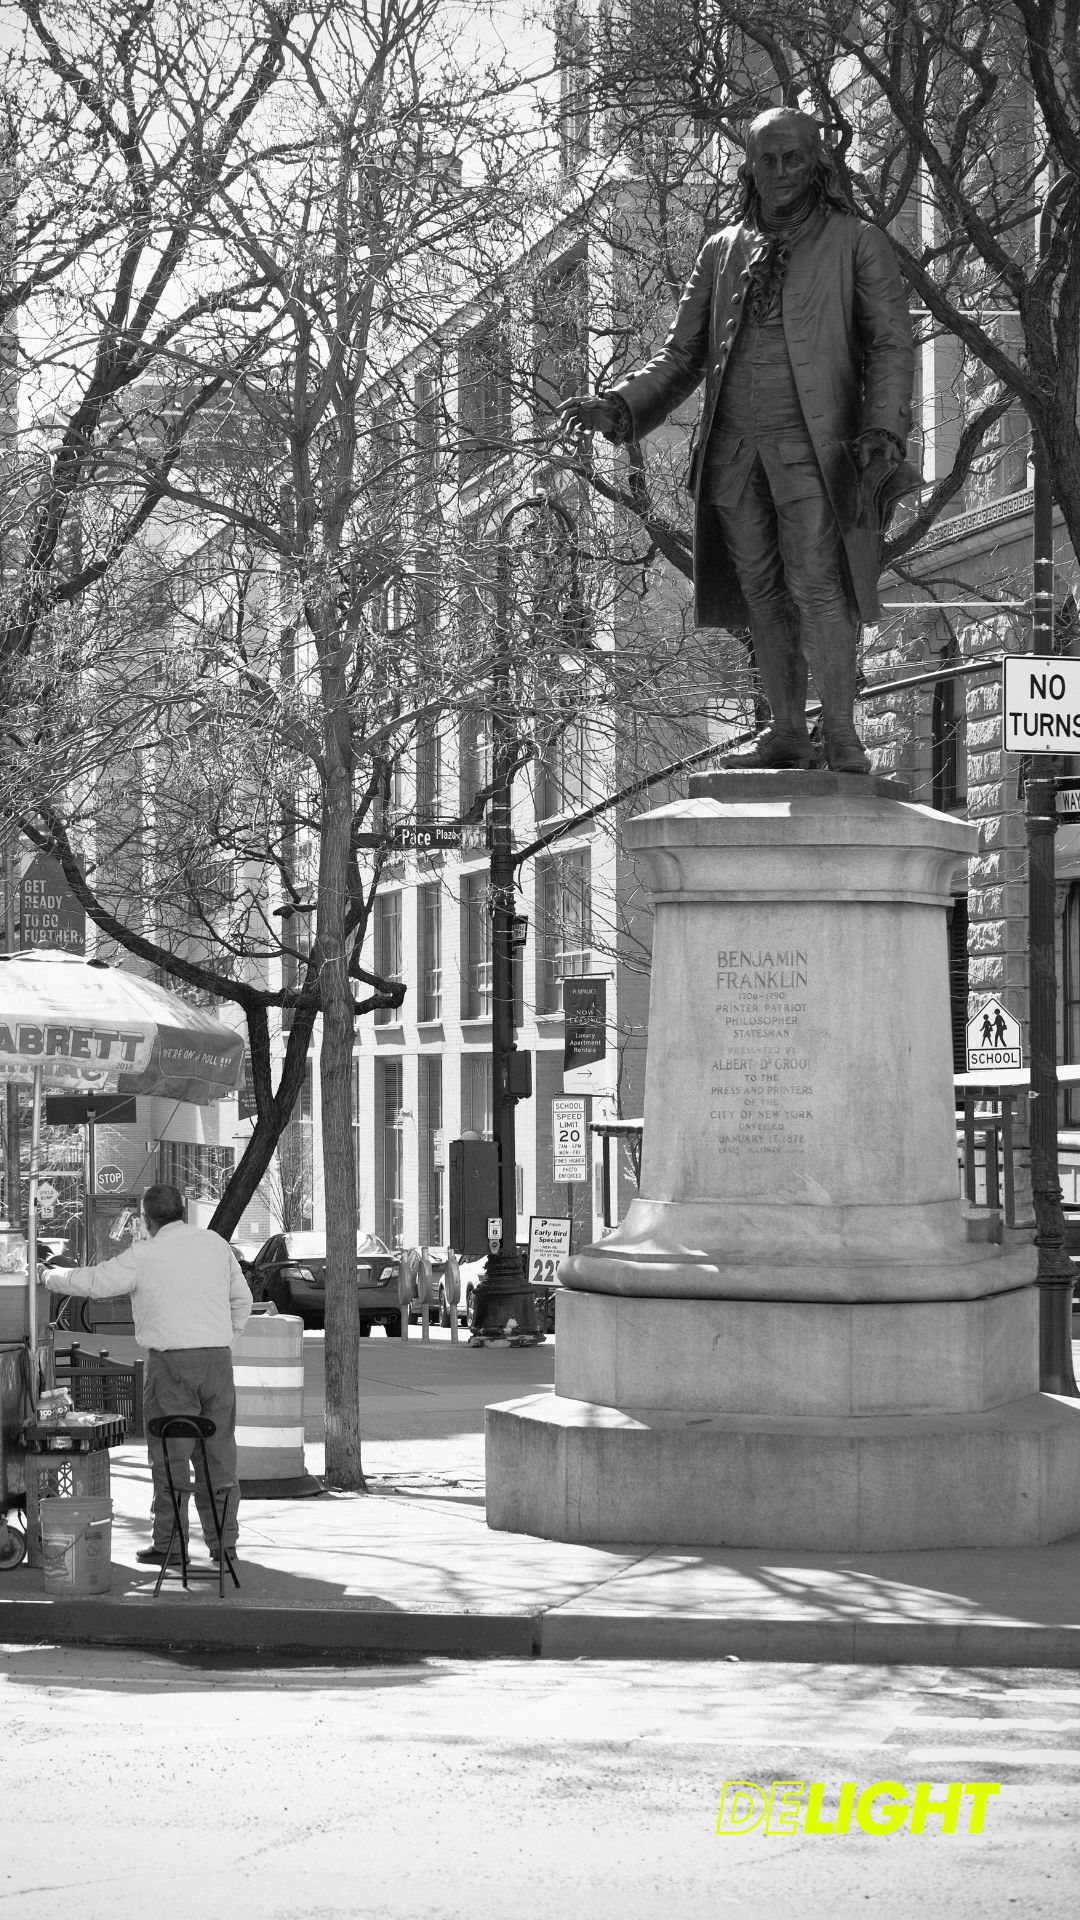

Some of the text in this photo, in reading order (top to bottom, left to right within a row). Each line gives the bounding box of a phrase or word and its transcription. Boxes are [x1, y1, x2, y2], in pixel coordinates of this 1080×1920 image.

[1030, 673, 1066, 700] NO
[402, 828, 431, 846] Pace
[24, 879, 47, 893] GET
[24, 895, 63, 909] READY
[24, 913, 59, 928] TO GO
[717, 950, 808, 968] BENJAMIN
[716, 970, 808, 989] FRANKLIN
[715, 1003, 807, 1013] PRINTER PATRIOT
[725, 1016, 798, 1025] PHILOSOPHER
[575, 1033, 596, 1041] Luxury
[733, 1029, 789, 1038] STATESMAN
[569, 1040, 601, 1048] Apartment
[183, 1049, 196, 1060] ON
[201, 1053, 218, 1066] ROLL
[971, 1052, 1018, 1065] SCHOOL
[115, 1062, 134, 1071] 2018
[711, 1058, 753, 1071] ALBERT
[774, 1057, 812, 1070] GROOT
[744, 1074, 779, 1082] TO THE
[711, 1085, 813, 1095] PRESS AND PRINTERS
[710, 1110, 813, 1120] CITY OF NEW YORK
[739, 1123, 784, 1131] UNVEILED
[559, 1130, 580, 1142] 20
[718, 1134, 763, 1144] JANUARY
[98, 1172, 122, 1184] STOP
[534, 1229, 552, 1237] Early
